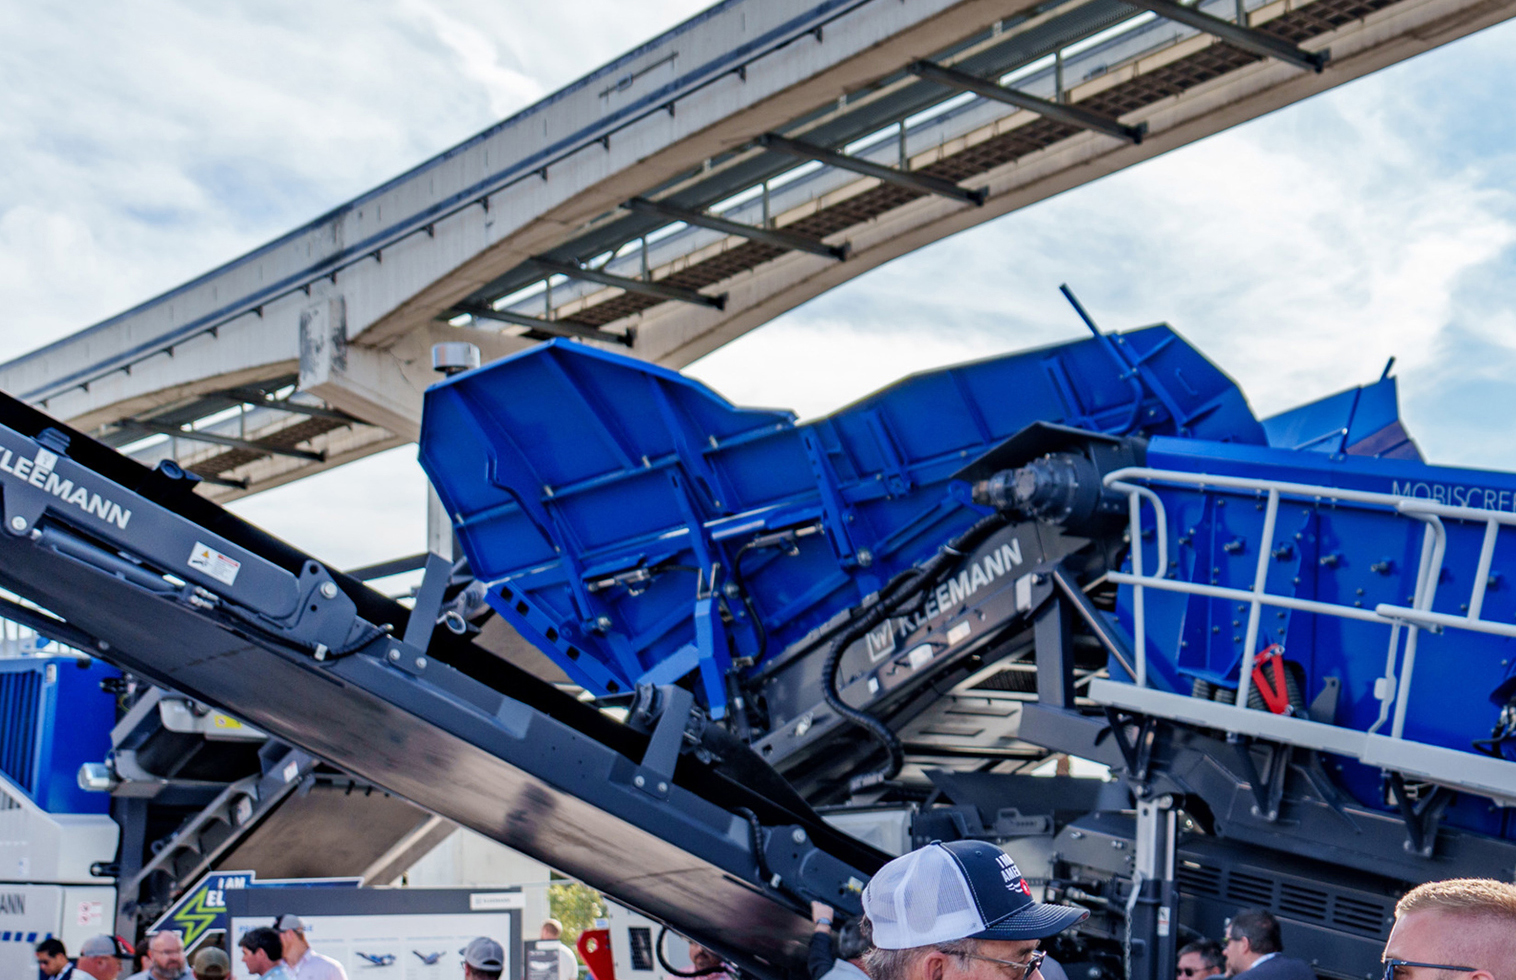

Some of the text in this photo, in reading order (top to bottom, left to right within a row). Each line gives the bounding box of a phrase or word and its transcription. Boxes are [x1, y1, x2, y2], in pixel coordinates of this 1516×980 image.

[0, 445, 131, 529] LEEMANN
[900, 538, 1023, 638] KLEEMANN
[225, 877, 246, 889] AM
